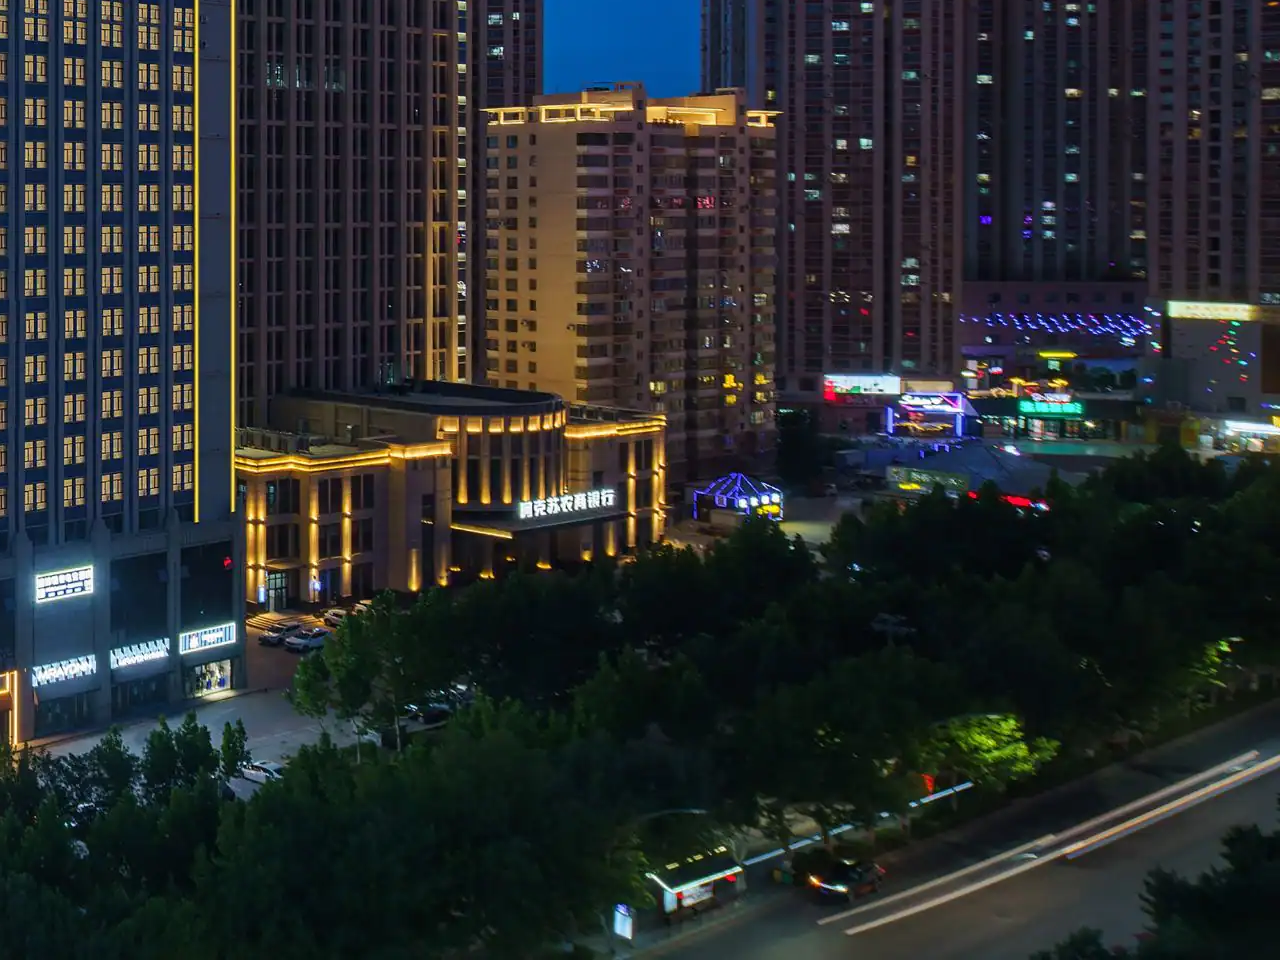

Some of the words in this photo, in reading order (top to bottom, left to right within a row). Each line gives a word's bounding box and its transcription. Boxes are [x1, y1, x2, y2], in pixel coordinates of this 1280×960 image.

[519, 488, 616, 519] 阿克苏农商银行
